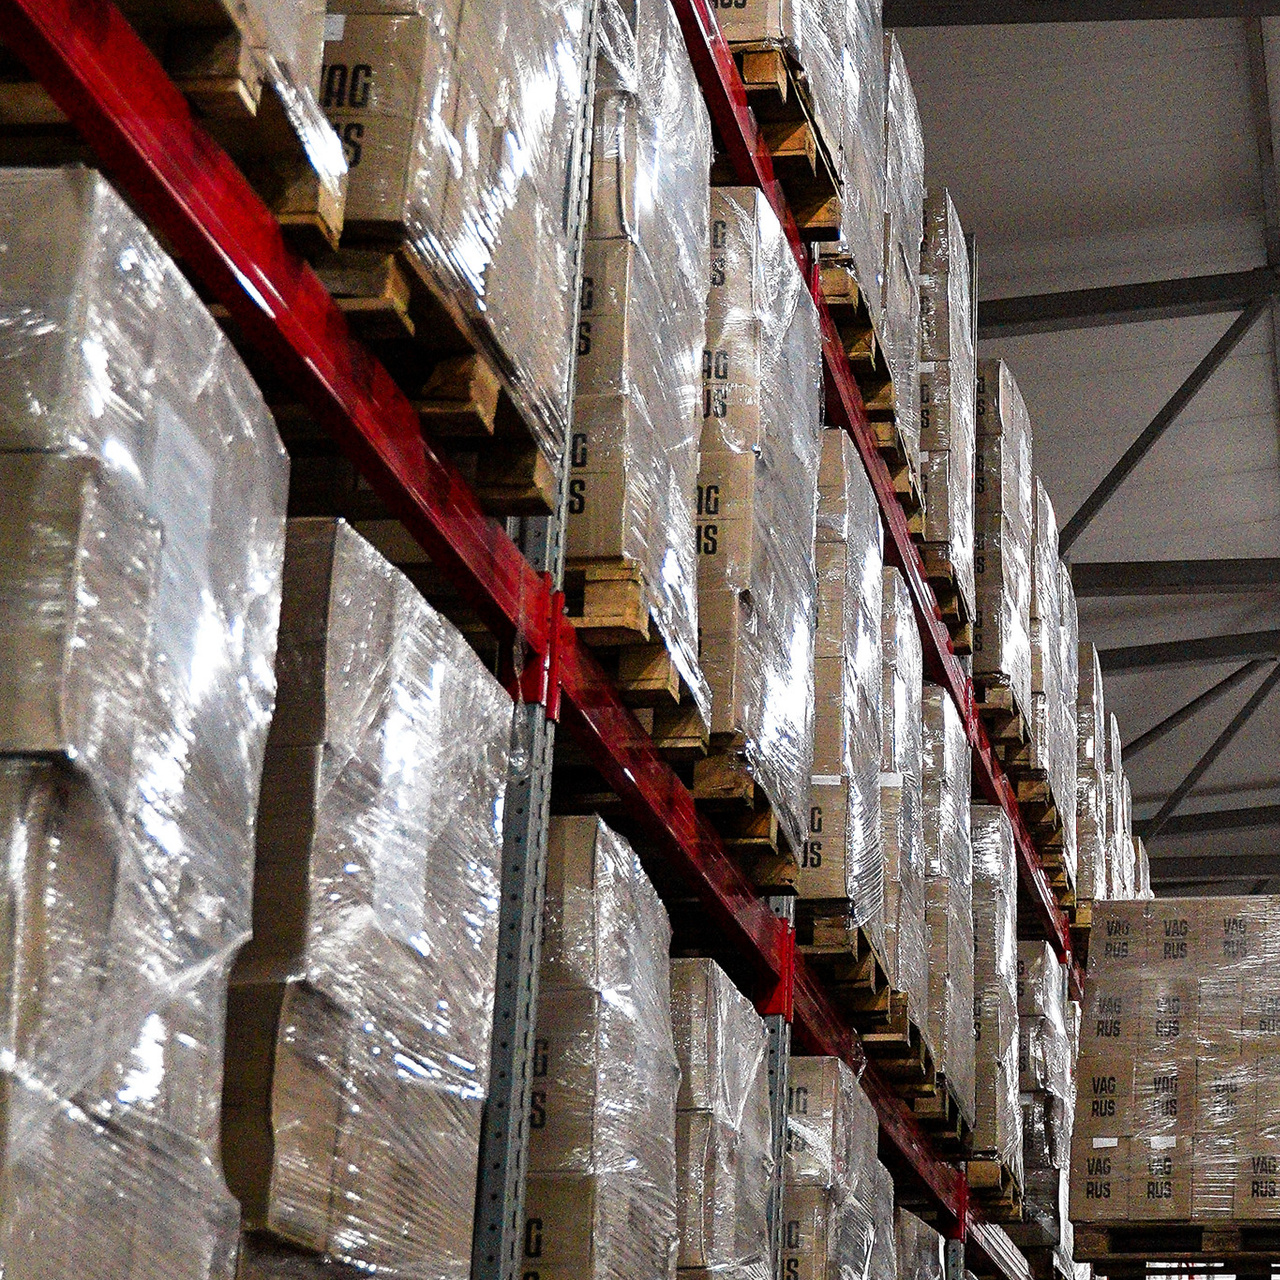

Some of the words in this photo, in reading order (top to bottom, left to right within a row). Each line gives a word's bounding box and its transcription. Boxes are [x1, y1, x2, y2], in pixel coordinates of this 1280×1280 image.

[320, 64, 372, 108] AG
[1106, 920, 1130, 937] VAG
[1164, 920, 1188, 937] VAG
[1163, 942, 1188, 959] RUS
[1097, 1020, 1121, 1037] RUS
[1092, 1077, 1116, 1094] VAG
[1092, 1100, 1115, 1117] RUS
[1086, 1158, 1111, 1175] VAG
[1252, 1157, 1277, 1174] VAG
[1086, 1181, 1111, 1198] RUS
[1147, 1181, 1172, 1198] RUS
[1251, 1180, 1277, 1198] RUS
